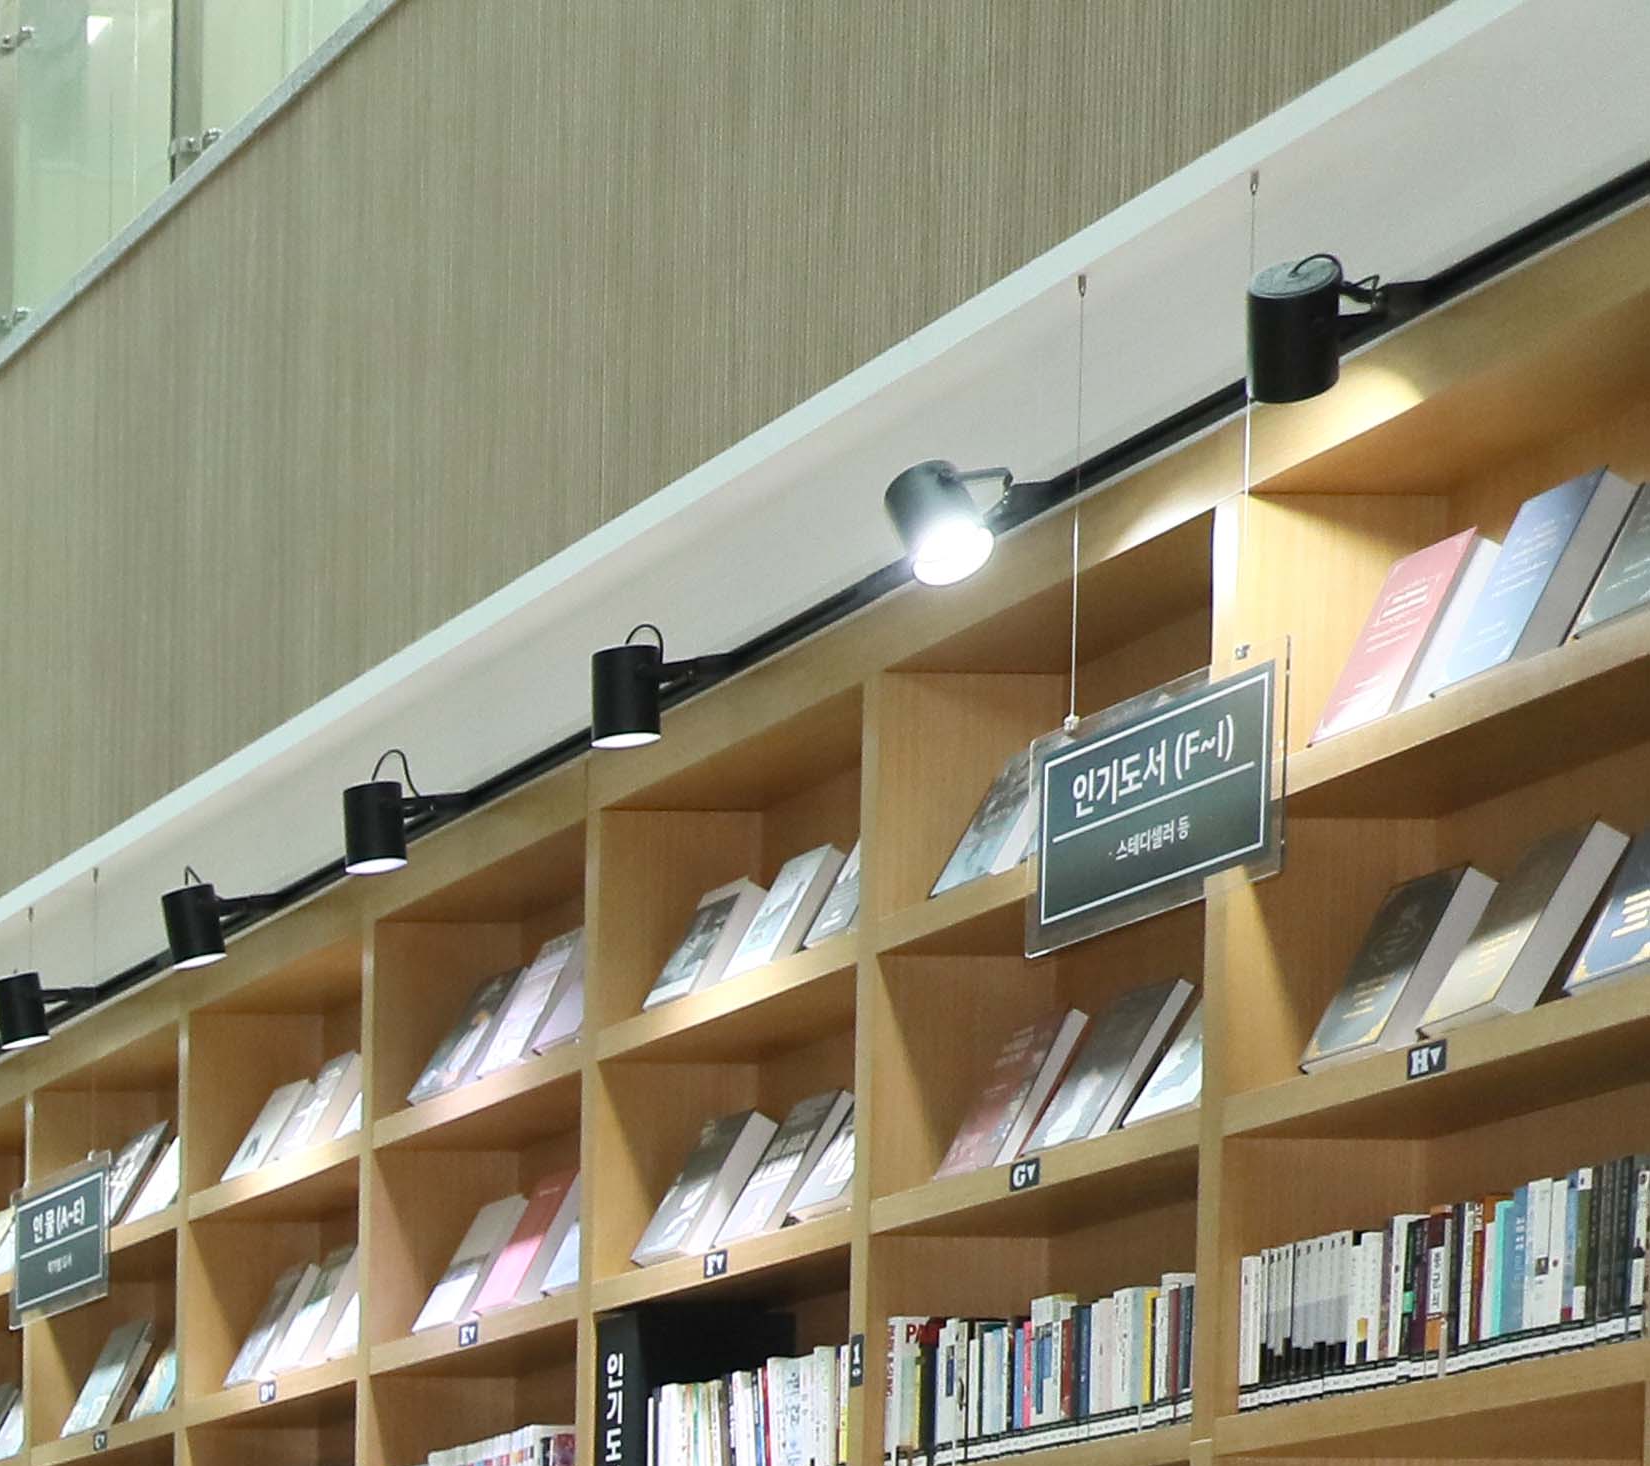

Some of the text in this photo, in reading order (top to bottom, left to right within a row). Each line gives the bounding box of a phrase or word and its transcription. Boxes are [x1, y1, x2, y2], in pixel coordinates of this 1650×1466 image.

[1072, 739, 1166, 818] 인기도서
[1115, 820, 1175, 861] 스테디셀러
[1410, 1049, 1430, 1076] H
[1013, 1166, 1026, 1189] G
